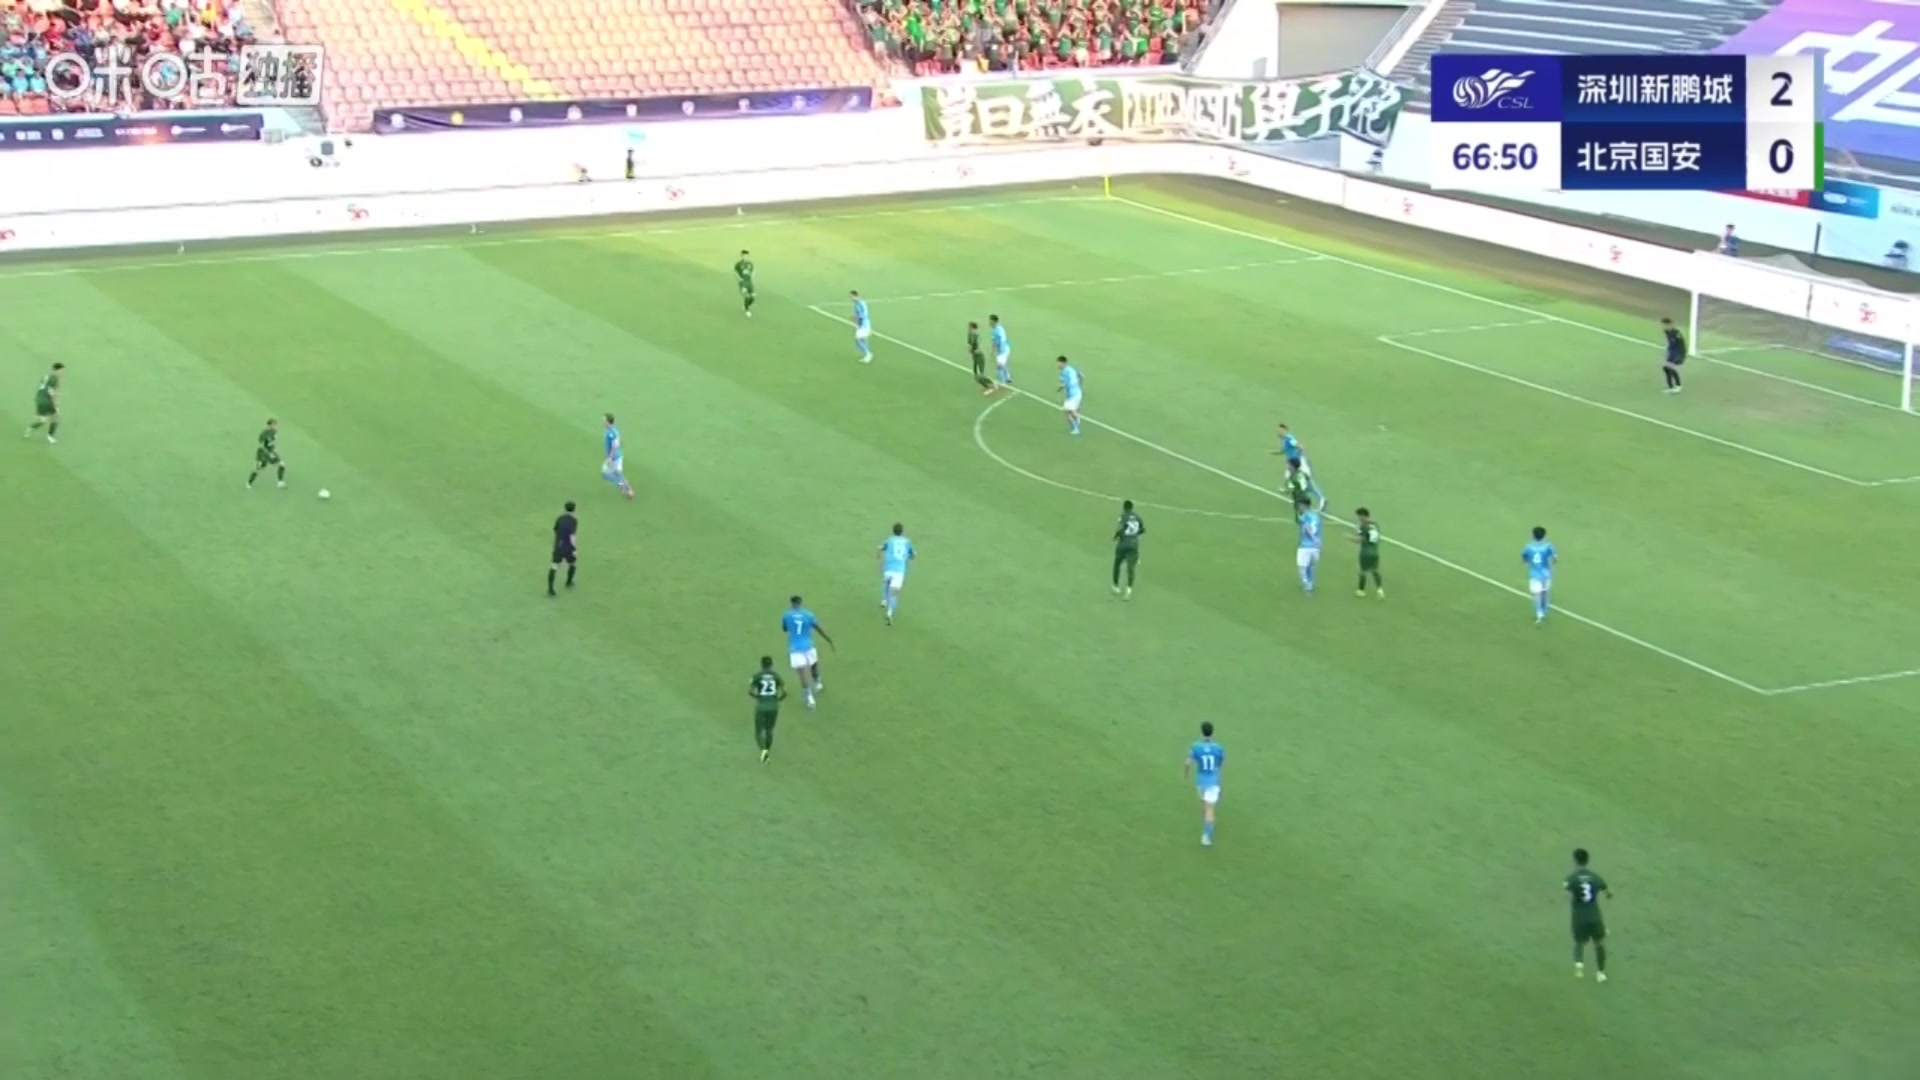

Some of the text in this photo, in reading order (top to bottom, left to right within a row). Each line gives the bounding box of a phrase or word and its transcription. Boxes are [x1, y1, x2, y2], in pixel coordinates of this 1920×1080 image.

[794, 620, 803, 635] 7
[760, 680, 776, 695] 23
[1200, 755, 1215, 770] 11
[1580, 883, 1592, 902] 3
